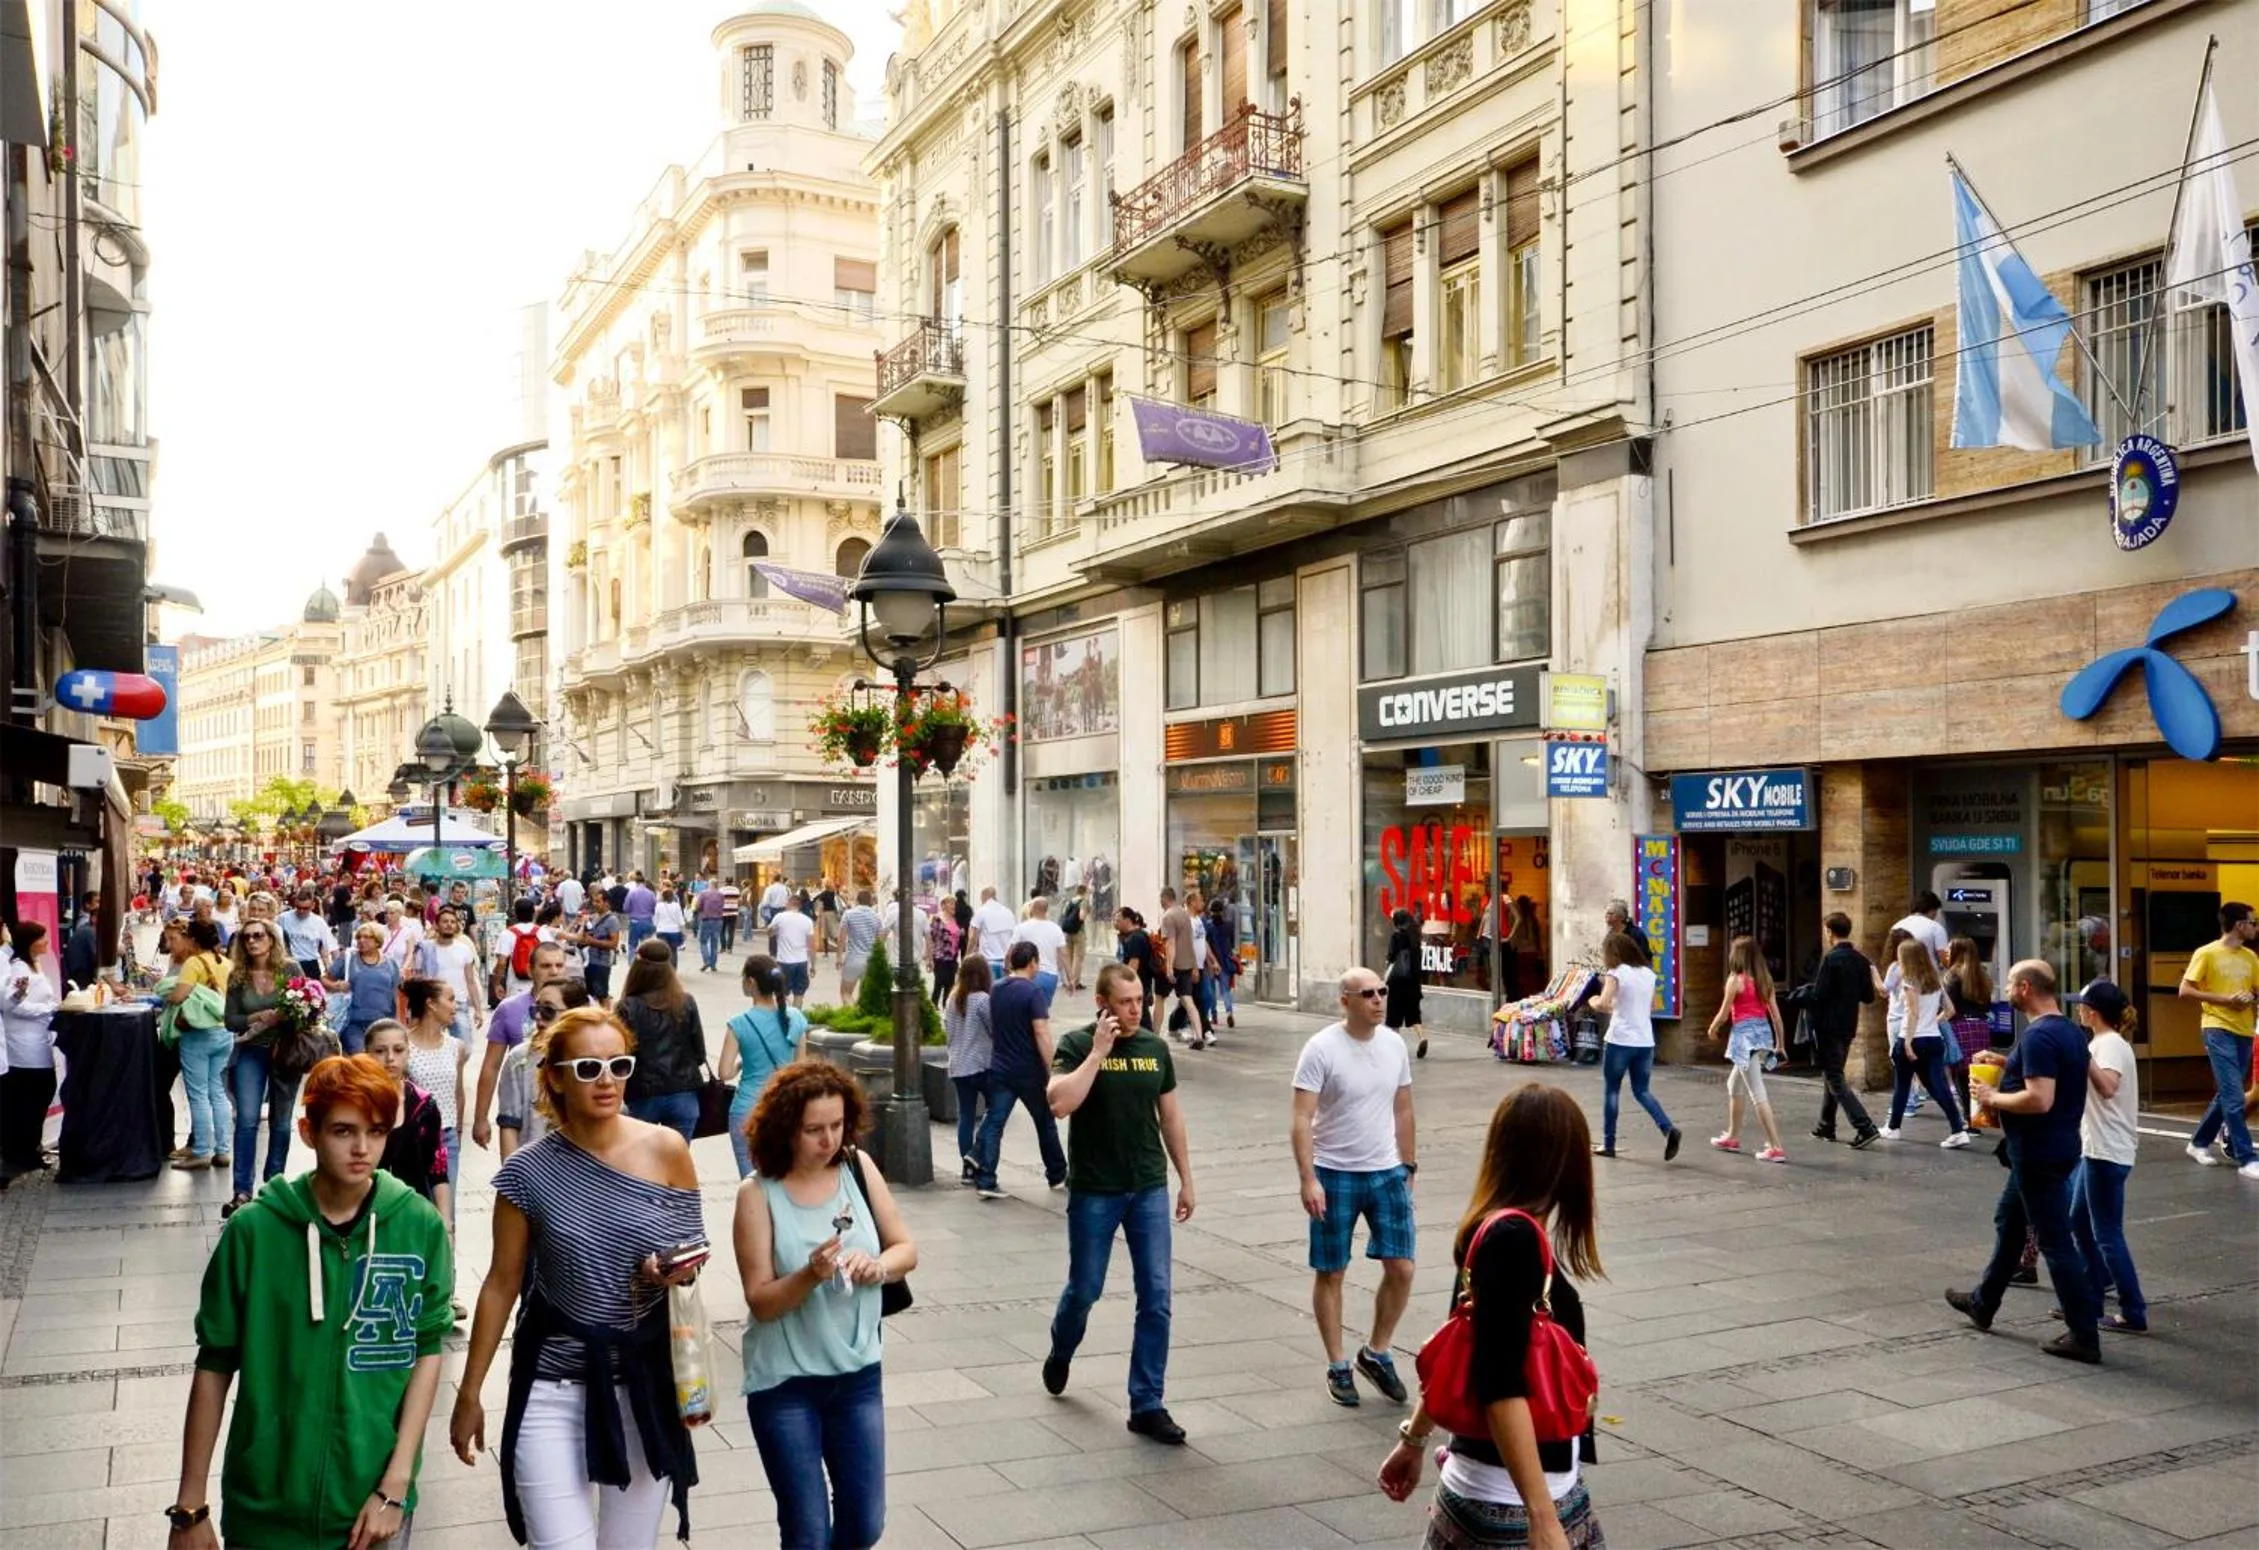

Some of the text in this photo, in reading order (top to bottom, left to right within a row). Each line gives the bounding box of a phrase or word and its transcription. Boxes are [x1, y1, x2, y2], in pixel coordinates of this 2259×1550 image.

[2136, 437, 2176, 487] ARGENTINA
[1379, 680, 1514, 727] CONVERSE
[1551, 746, 1603, 774] SKY
[1423, 774, 1445, 785] GOOD
[1446, 773, 1463, 783] KIND
[830, 790, 878, 805] PANDO
[1419, 785, 1443, 796] CHEAP
[1705, 775, 1802, 809] SKY MOBILE
[1931, 838, 1966, 851] SVUDA
[1968, 837, 1989, 850] GDE
[1380, 824, 1474, 923] SALE
[2151, 868, 2207, 880] Telenor banka
[1421, 941, 1453, 972] ŽENJE
[1098, 1058, 1160, 1072] RISH TRUE
